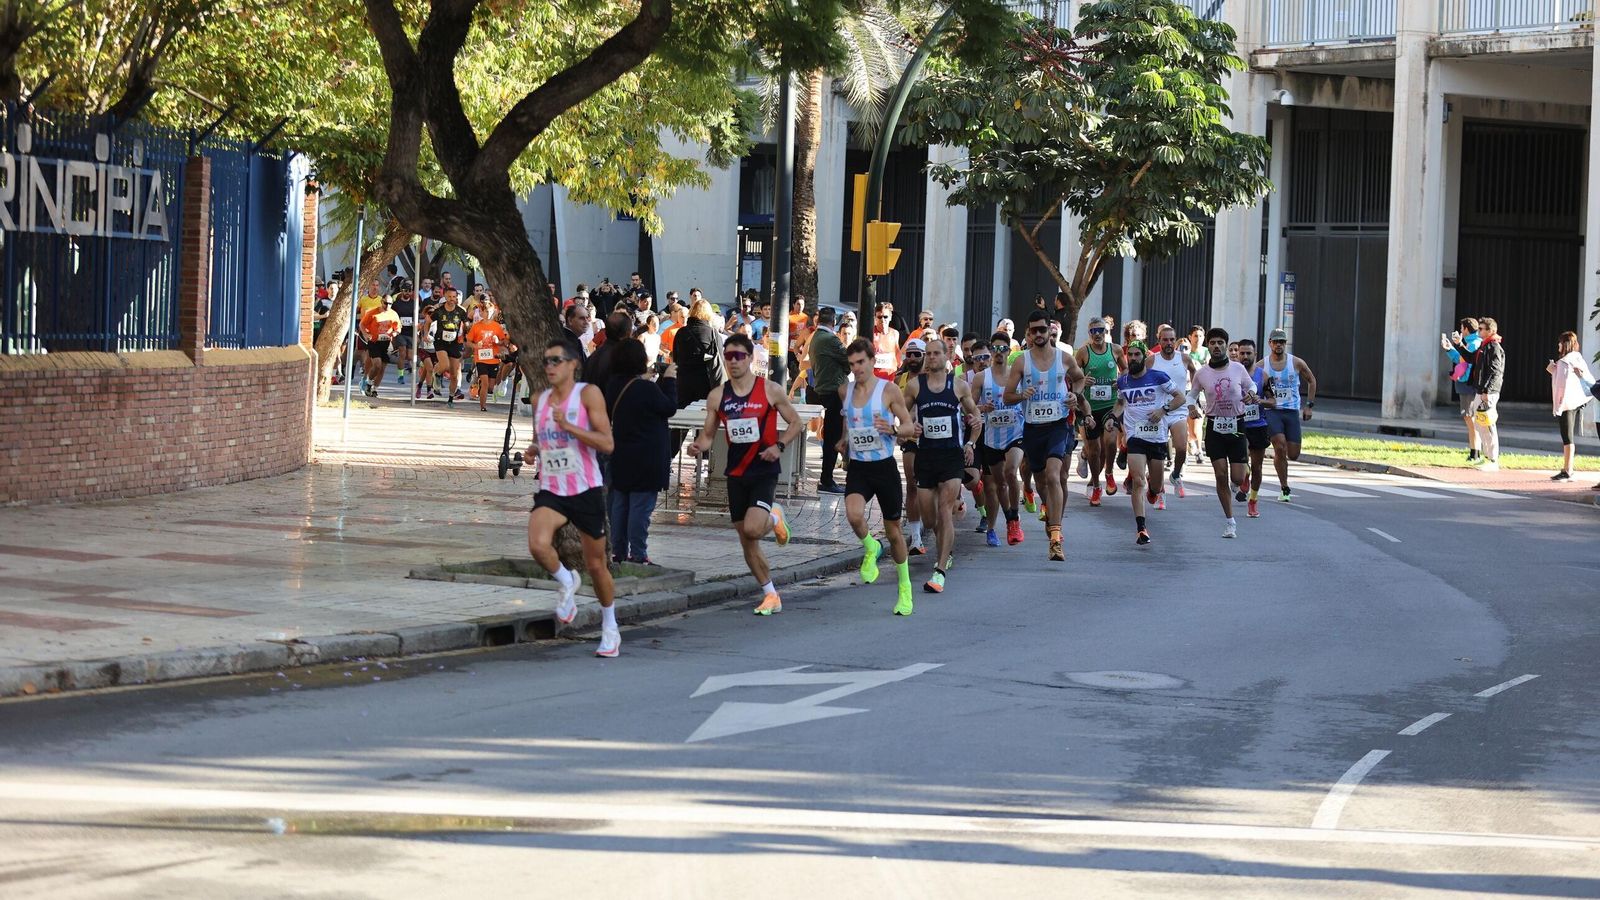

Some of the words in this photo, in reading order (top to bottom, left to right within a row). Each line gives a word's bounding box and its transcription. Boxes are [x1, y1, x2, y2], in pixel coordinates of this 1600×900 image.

[1123, 388, 1156, 404] VAS
[1034, 408, 1053, 416] 870
[991, 415, 1010, 423] 312
[927, 424, 947, 433] 390
[1216, 422, 1234, 430] 324
[731, 426, 753, 437] 694
[853, 435, 874, 445] 330
[546, 457, 568, 468] 117
